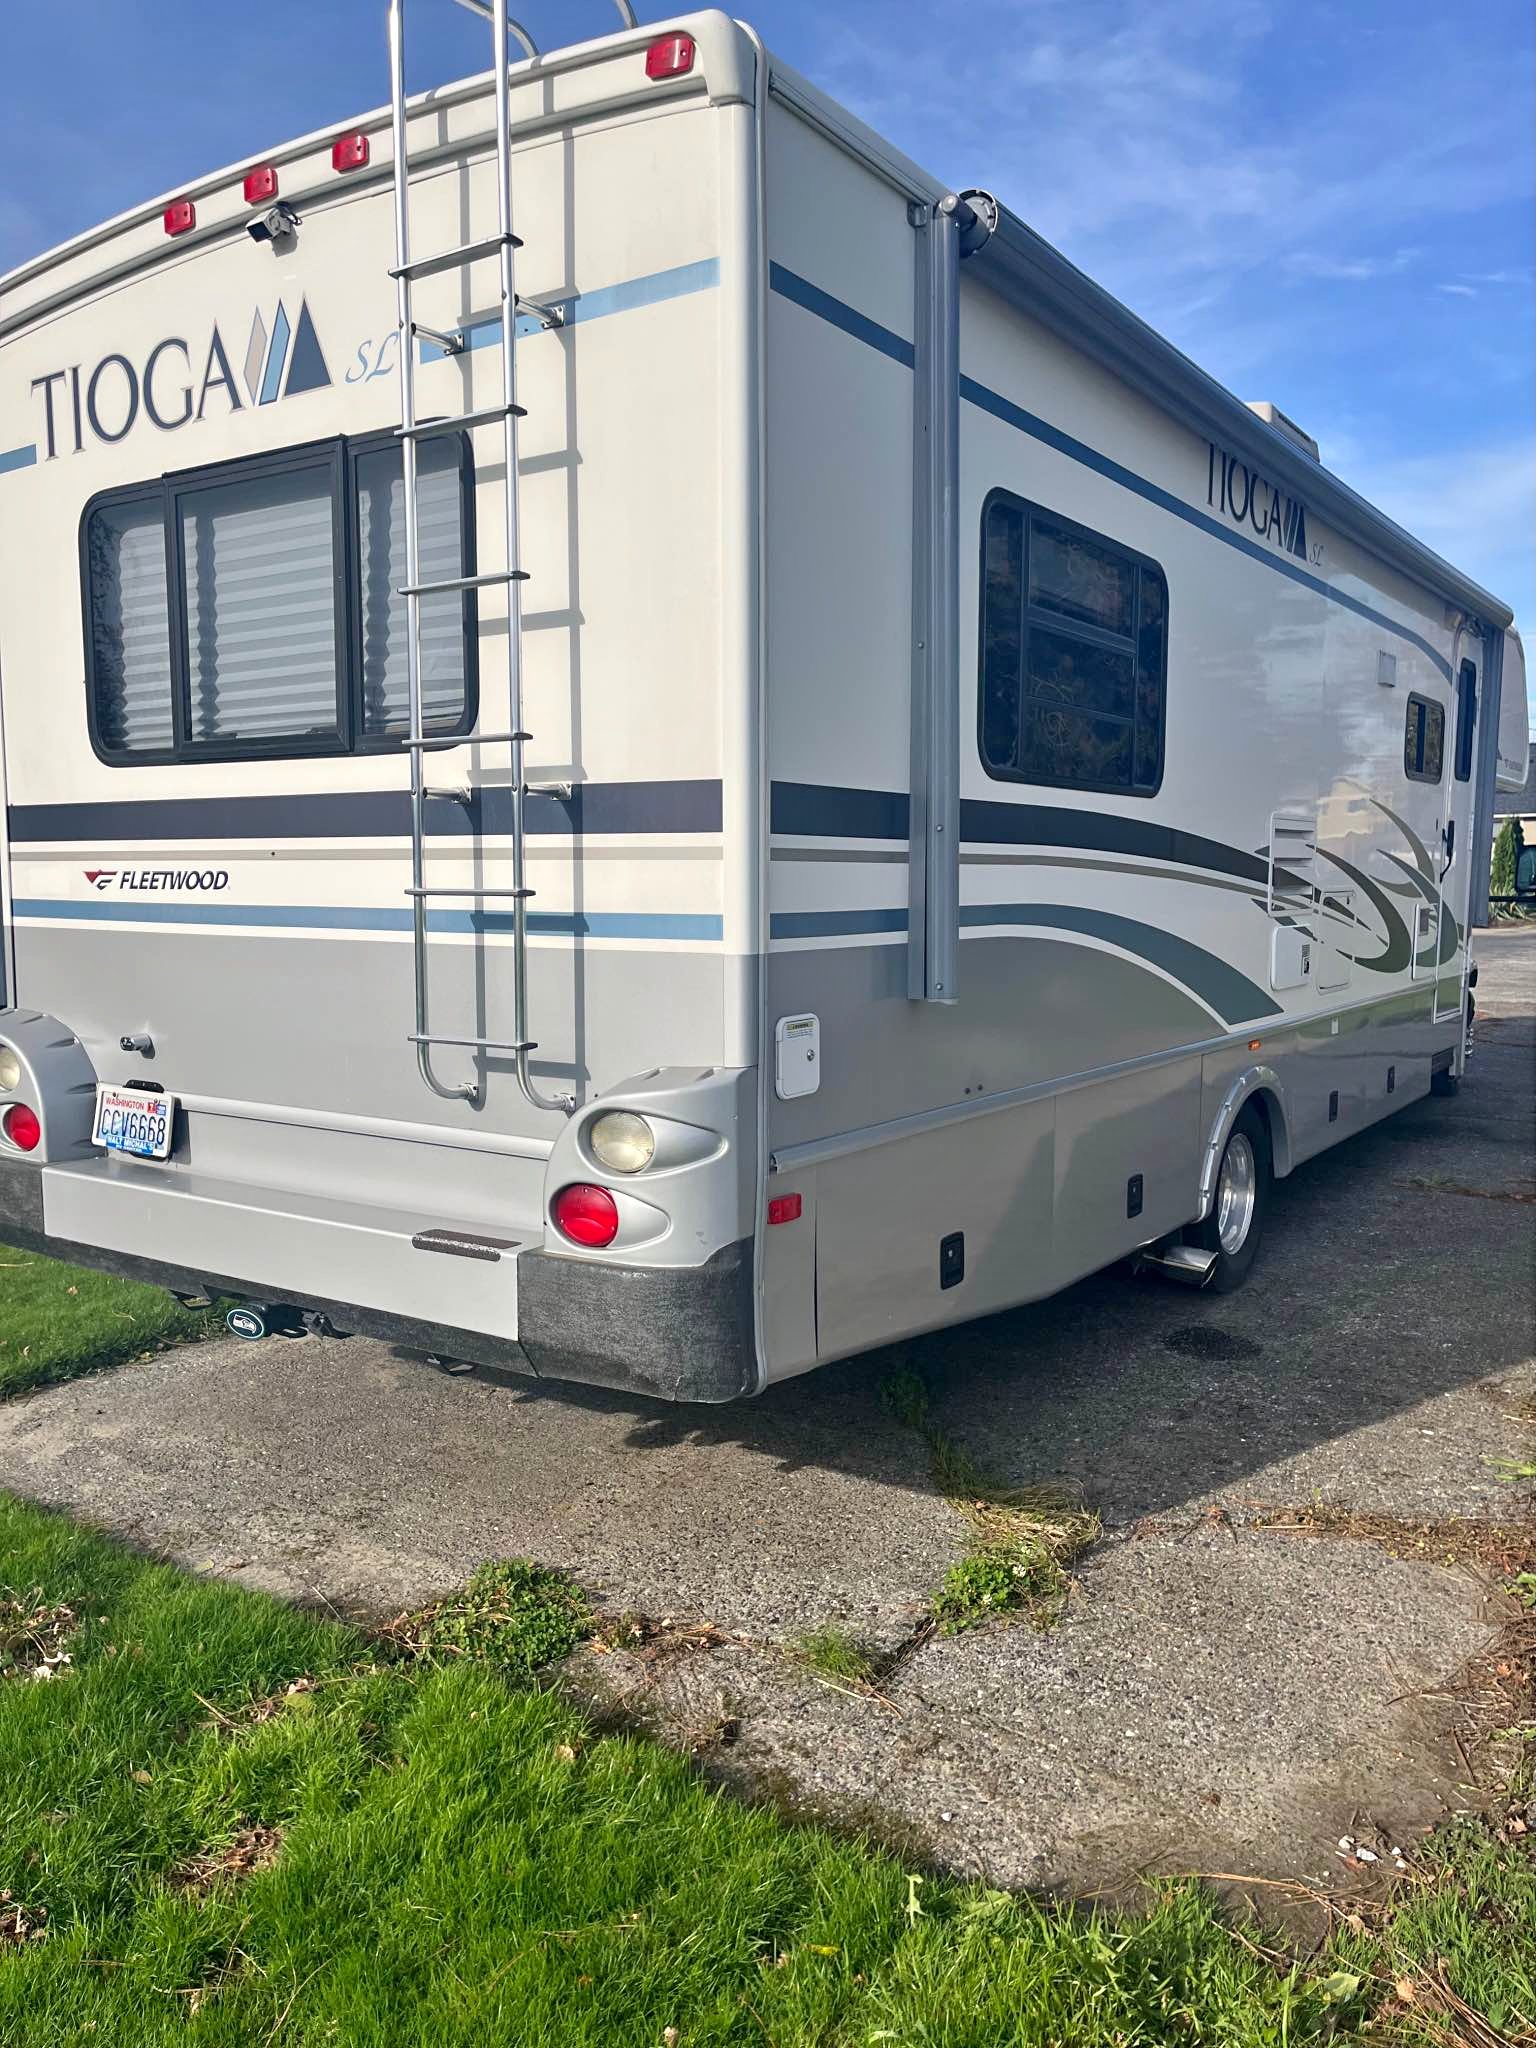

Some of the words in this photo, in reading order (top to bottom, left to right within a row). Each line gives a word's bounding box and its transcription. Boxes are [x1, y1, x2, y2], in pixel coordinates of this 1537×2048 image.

[31, 318, 246, 462] TIOGA
[345, 331, 400, 383] SL
[1207, 443, 1283, 548] TIOGA
[119, 870, 229, 890] FLEETWOOD
[105, 1096, 145, 1110] WASHINGTON
[101, 1108, 166, 1145] CCV6668
